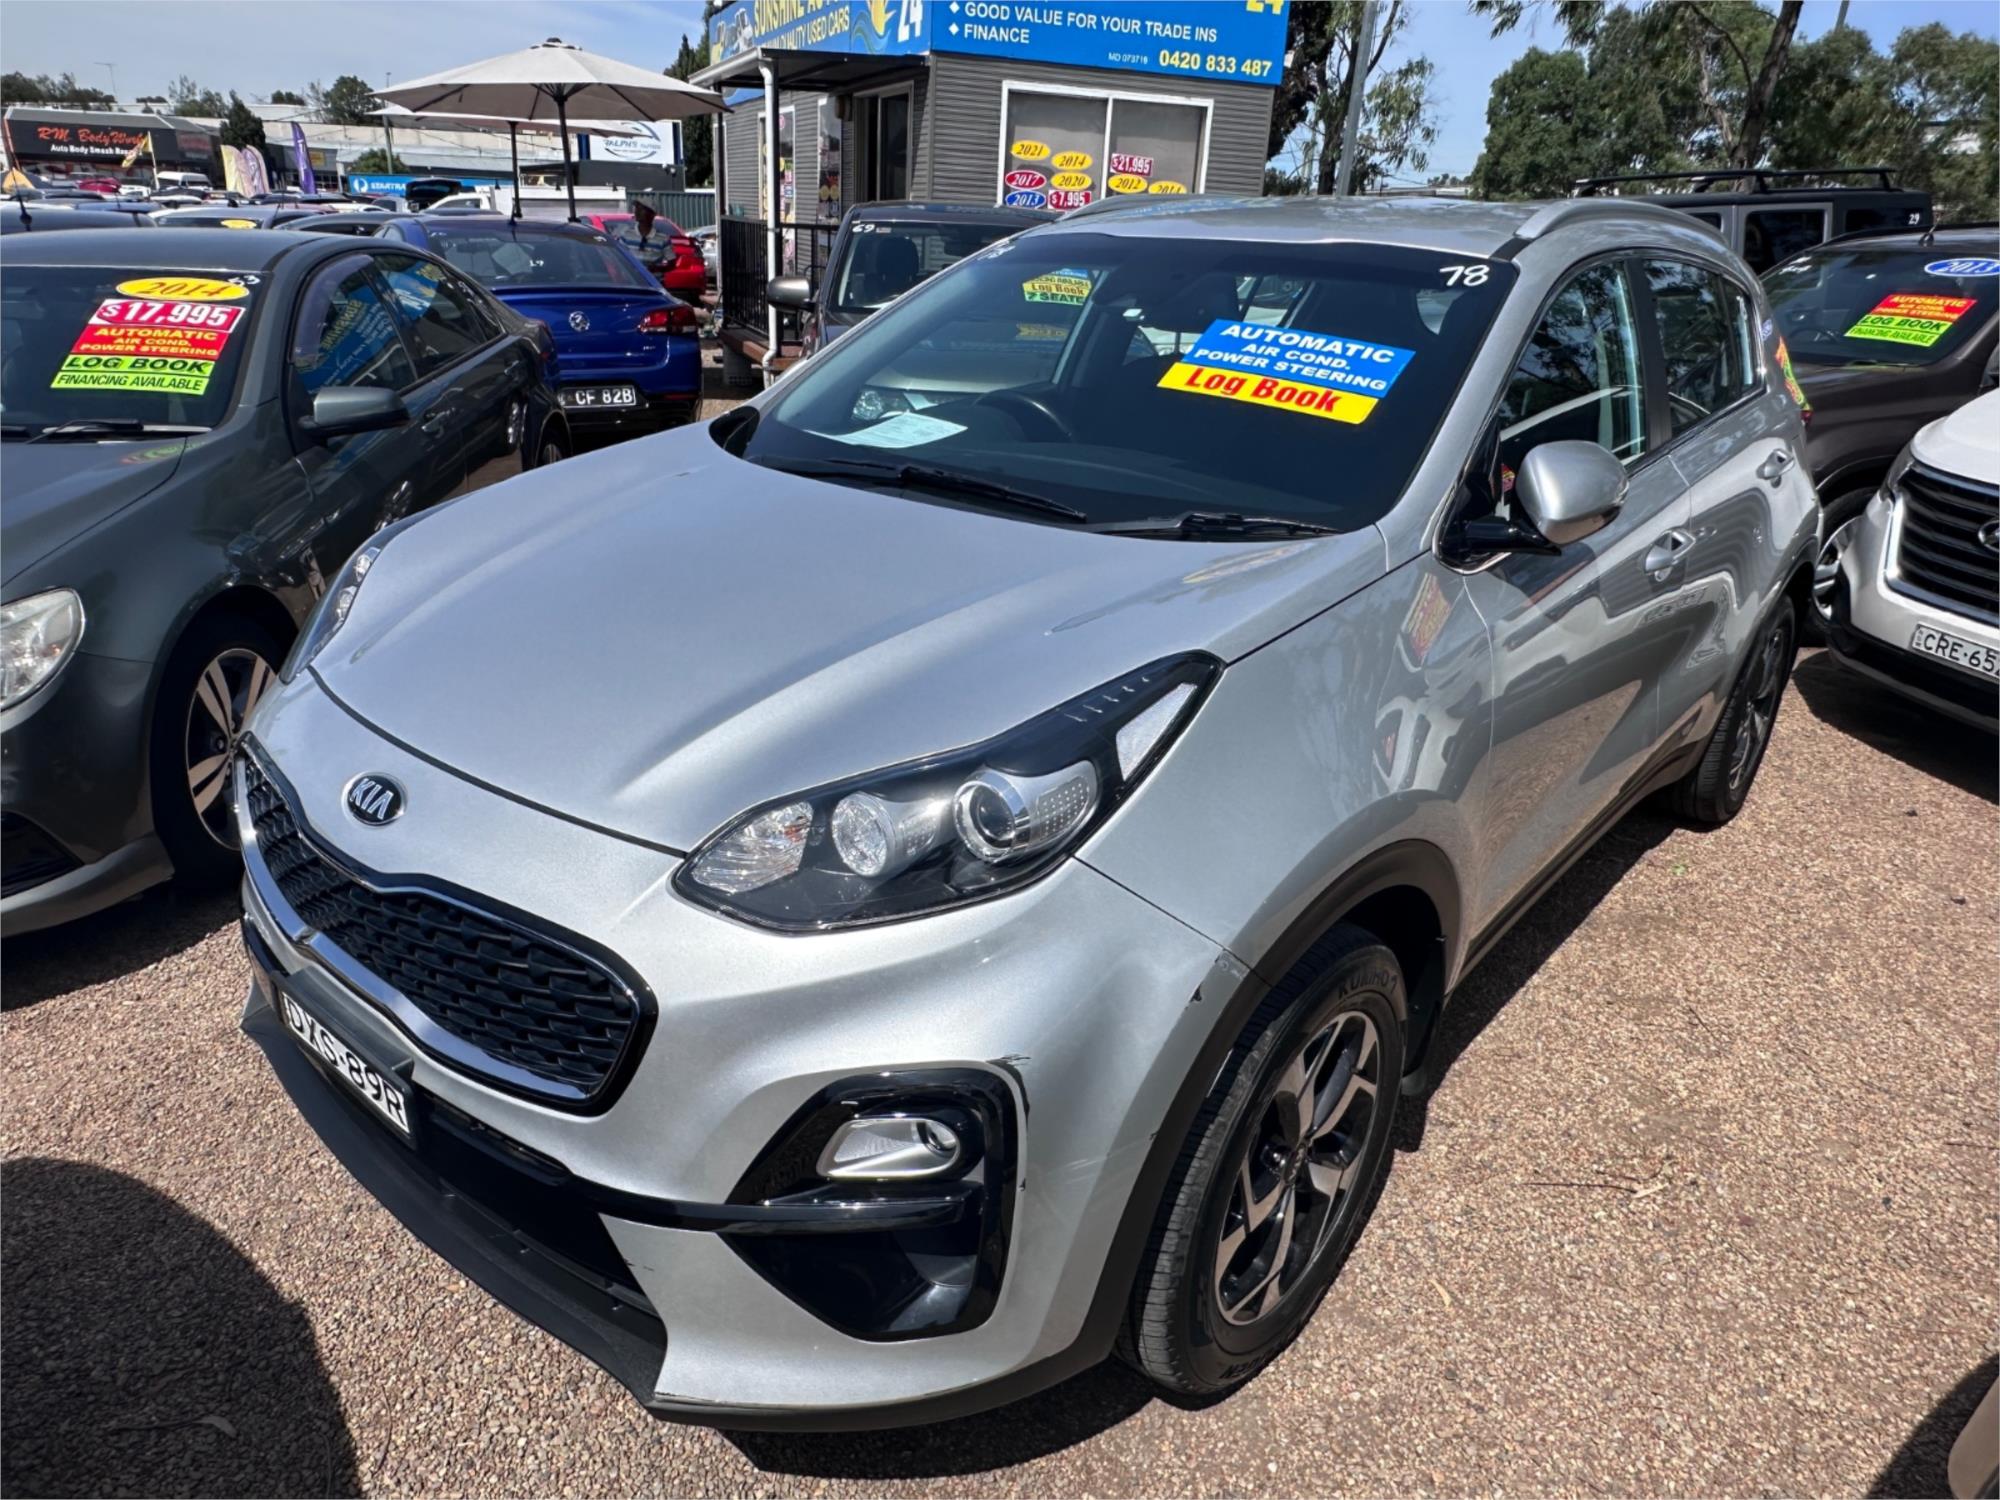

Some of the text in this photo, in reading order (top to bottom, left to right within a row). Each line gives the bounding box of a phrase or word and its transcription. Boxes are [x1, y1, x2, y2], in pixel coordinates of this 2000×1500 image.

[807, 16, 827, 45] USED
[828, 5, 850, 36] CARS
[964, 2, 1218, 43] GOOD VALUE FOR YOUR TRADE INS
[964, 23, 1031, 44] FINANCE
[1108, 52, 1121, 62] MD
[1159, 49, 1273, 78] 0420 833 487
[50, 144, 69, 153] Auto
[70, 145, 88, 154] Body
[90, 146, 114, 154] Smash
[1015, 144, 1044, 157] 2021
[1059, 155, 1087, 167] 2014
[1113, 156, 1150, 174] $21,995
[1012, 174, 1039, 186] 2017
[1058, 175, 1085, 187] 2020
[1116, 177, 1141, 190] 2012
[1013, 194, 1039, 206] 2013
[1051, 192, 1086, 208] $7,995
[1908, 213, 1921, 225] 29
[852, 224, 875, 233] 69
[1439, 264, 1490, 287] 78
[135, 281, 228, 297] 2014
[1056, 284, 1084, 295] Book
[1890, 295, 1968, 307] AUTOMATIC
[102, 302, 232, 326] $17,995
[1860, 316, 1948, 331] LOG BOOK
[94, 328, 218, 341] AUTOMATIC
[145, 339, 191, 347] COND.
[1220, 324, 1395, 363] AUTOMATIC
[139, 346, 218, 356] STEERING
[1241, 343, 1350, 370] AIR COND.
[65, 356, 209, 374] LOG BOOK
[1193, 348, 1388, 391] POWER STEERING
[57, 374, 203, 391] FINANCING AVAILABLE
[1185, 367, 1343, 413] Log Book
[349, 778, 394, 820] KIA
